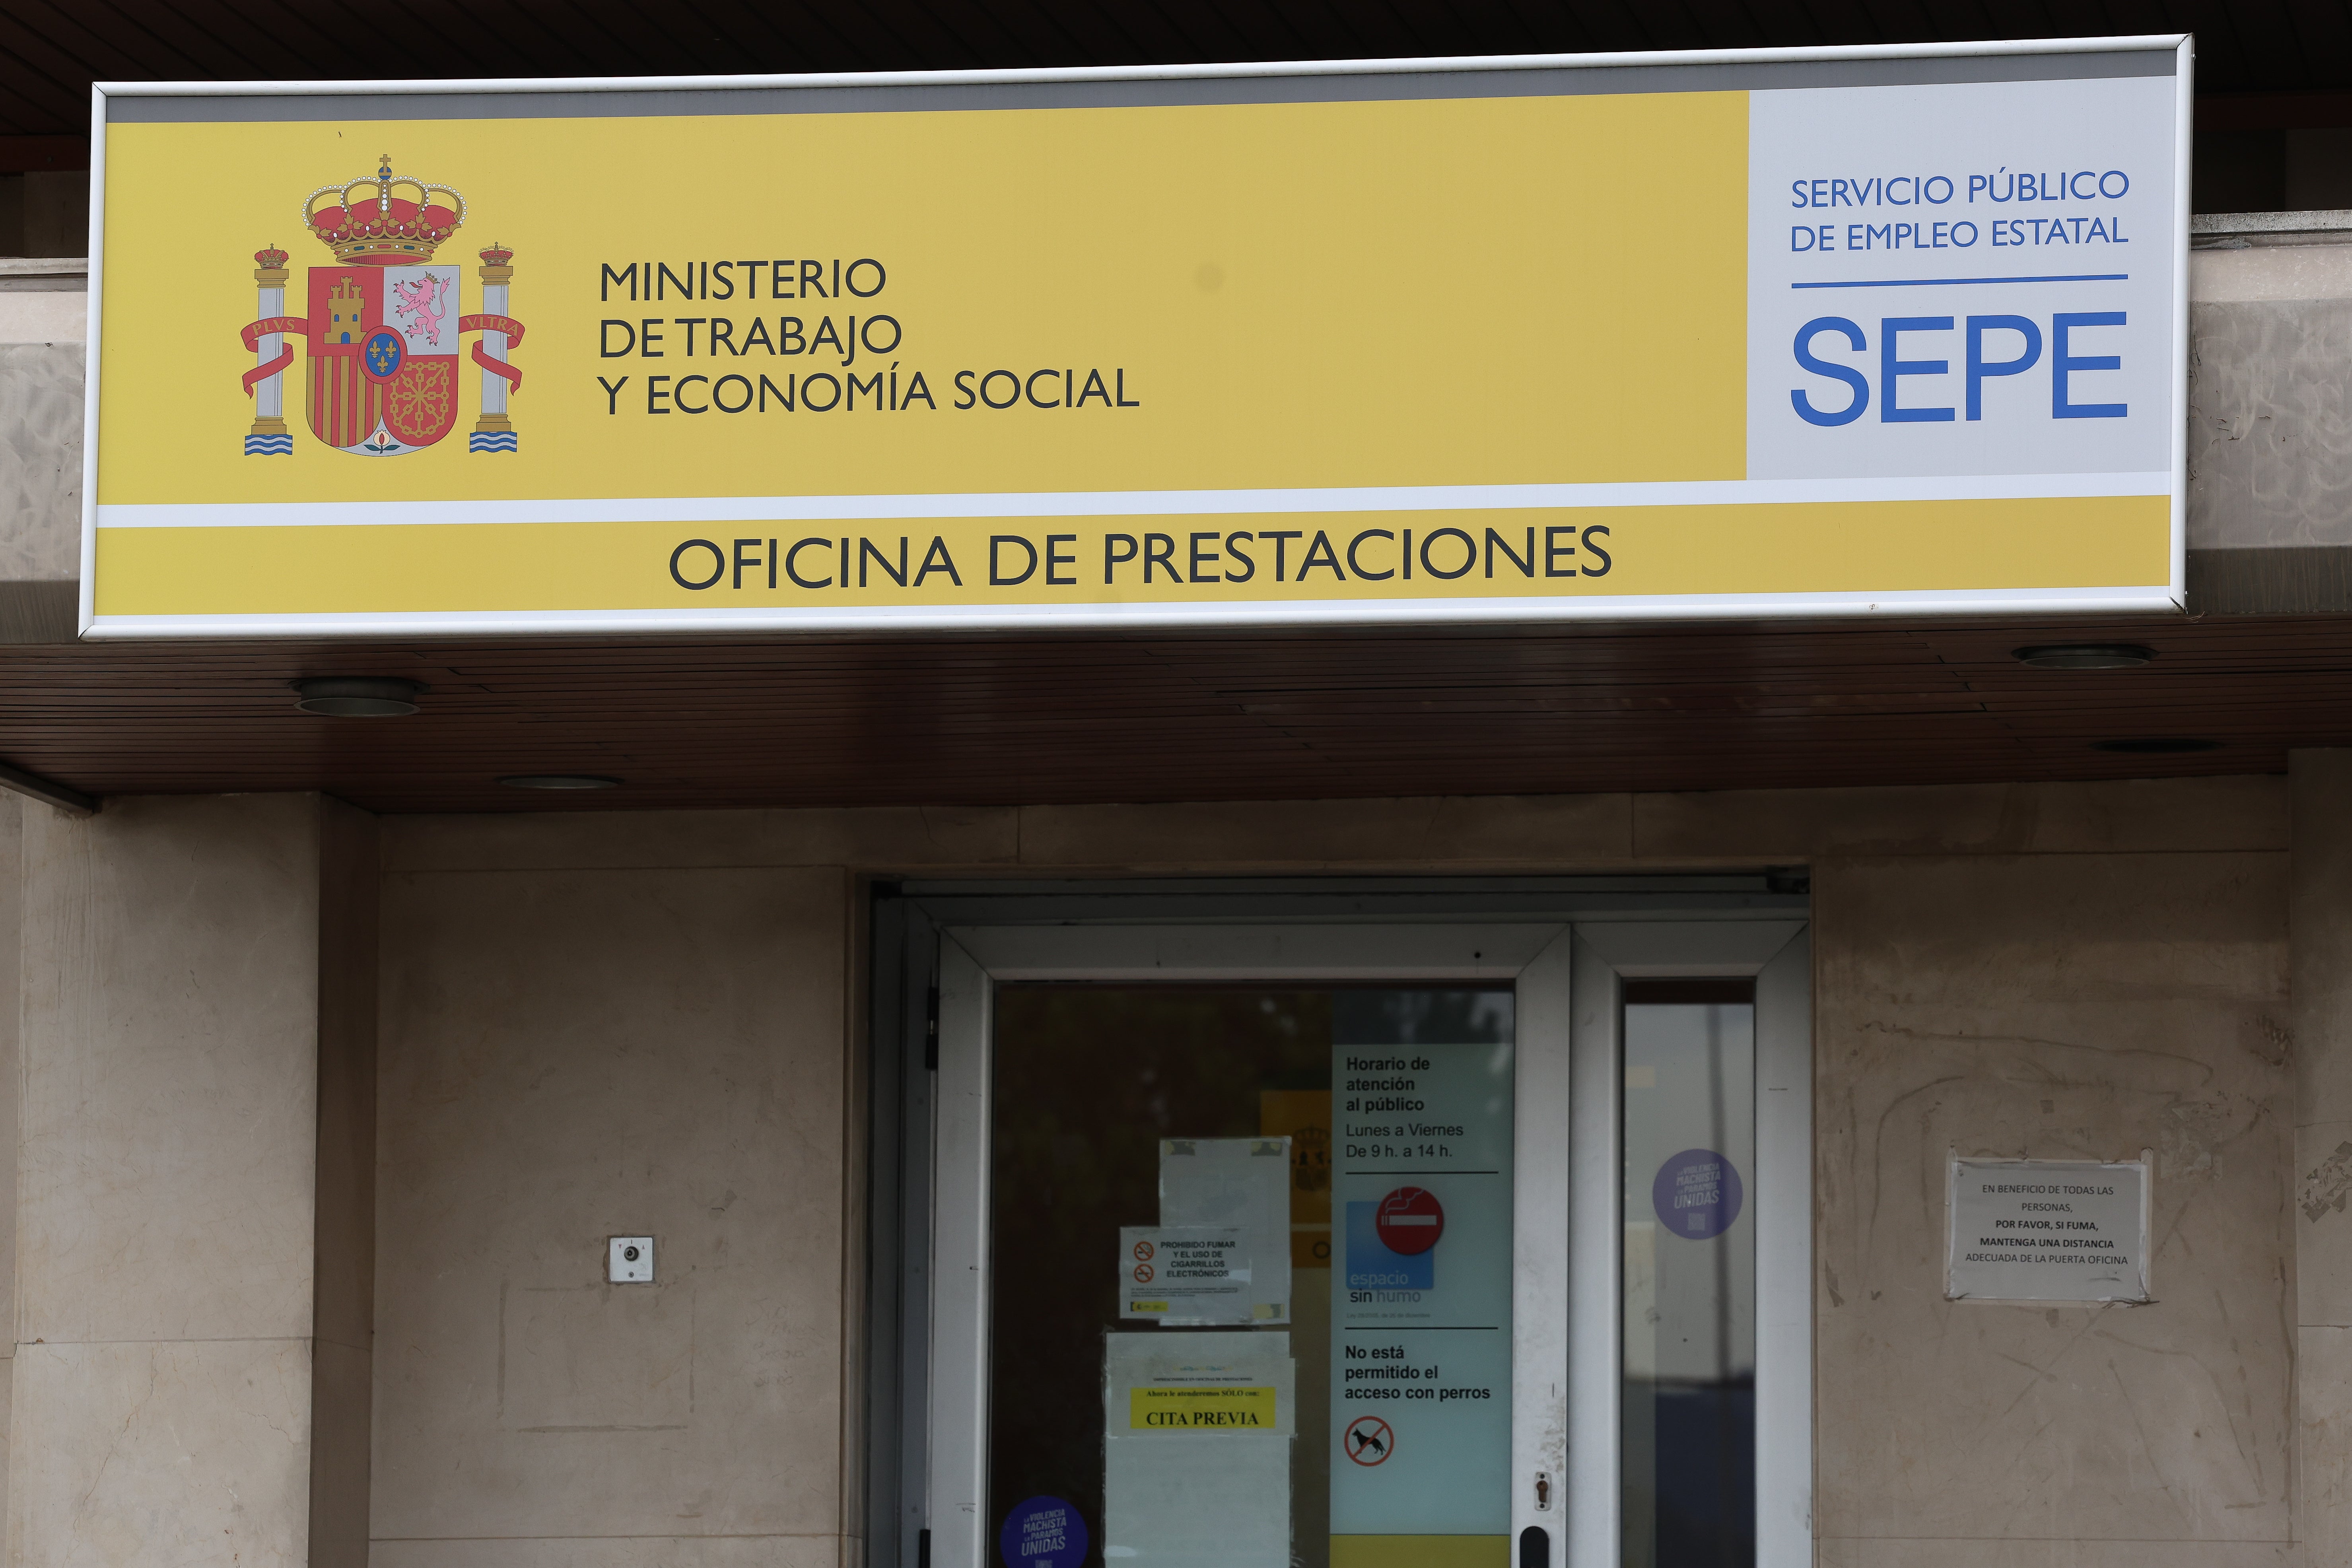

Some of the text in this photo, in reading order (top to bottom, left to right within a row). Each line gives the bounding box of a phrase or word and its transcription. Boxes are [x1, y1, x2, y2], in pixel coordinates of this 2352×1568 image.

[1792, 166, 2129, 208] SERVICIO PÚBLICO
[1791, 217, 2129, 252] DE EMPLEO ESTATAL
[601, 258, 886, 301] MINISTERIO
[252, 317, 519, 336] PLVS VLTRA
[600, 315, 902, 367] DE TRABAJO
[1791, 311, 2128, 427] SEPE
[597, 361, 1140, 415] Y ECONOMÍA SOCIAL
[669, 524, 1613, 591] OFICINA DE PRESTACIONES
[1347, 1057, 1431, 1071] Horario de
[1346, 1077, 1415, 1091] atención
[1346, 1097, 1424, 1114] al público
[1346, 1123, 1464, 1137] Lunes a Viernes
[1346, 1144, 1452, 1157] De 9 h. a 14 h.
[1983, 1185, 2114, 1195] EN BENEFICIO DE TODAS LAS
[1674, 1189, 1720, 1209] UNIDAS
[2022, 1203, 2073, 1213] PERSONAS,
[1996, 1220, 2015, 1228] POR
[2018, 1220, 2053, 1230] FAVOR,
[2067, 1221, 2098, 1231] FUMA,
[1980, 1238, 2114, 1248] MANTENGA UNA DISTANCIA
[1966, 1253, 2128, 1264] ADECUADA DE LA PUERTA OFICINA
[1167, 1269, 1229, 1278] ELECTRÓNICOS
[1350, 1271, 1409, 1288] espacio
[1350, 1288, 1421, 1303] sin humo
[1345, 1345, 1405, 1359] No está
[1345, 1366, 1438, 1382] permitido el
[1221, 1388, 1243, 1397] SÓLO
[1345, 1388, 1491, 1402] acceso con perros
[1146, 1412, 1259, 1425] CITA PREVIA
[1030, 1508, 1065, 1521] VIOLENCIA
[1023, 1517, 1067, 1533] MACHISTA
[1031, 1528, 1063, 1540] PARAMOS
[1021, 1536, 1066, 1556] UNIDAS
